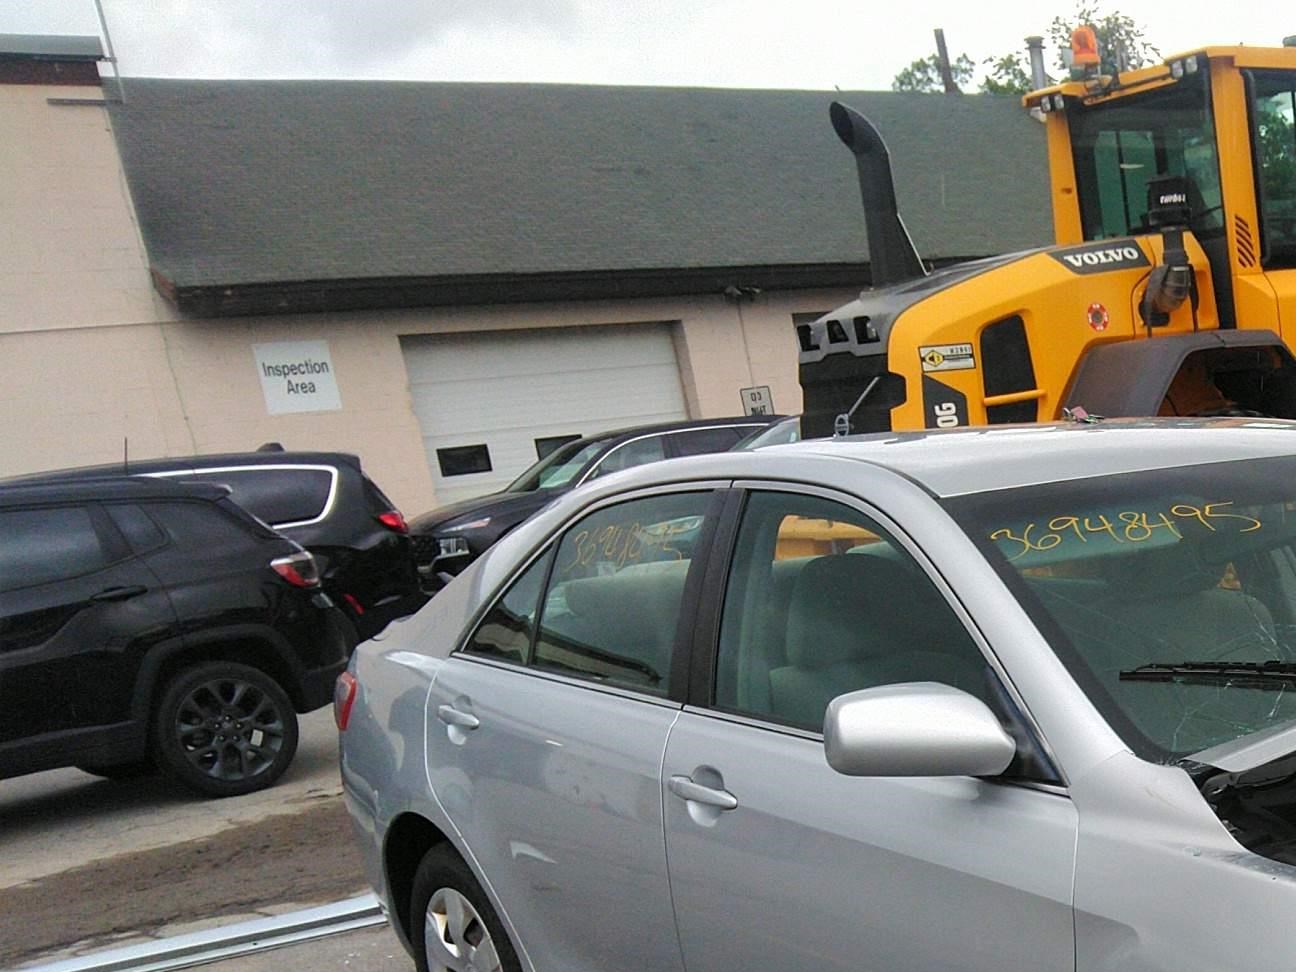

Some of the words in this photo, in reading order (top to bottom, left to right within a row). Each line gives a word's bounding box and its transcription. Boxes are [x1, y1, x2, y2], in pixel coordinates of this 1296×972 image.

[1064, 247, 1139, 267] VOLVO
[262, 359, 329, 379] Inspection
[287, 379, 316, 394] Area
[990, 501, 1262, 562] 36948495
